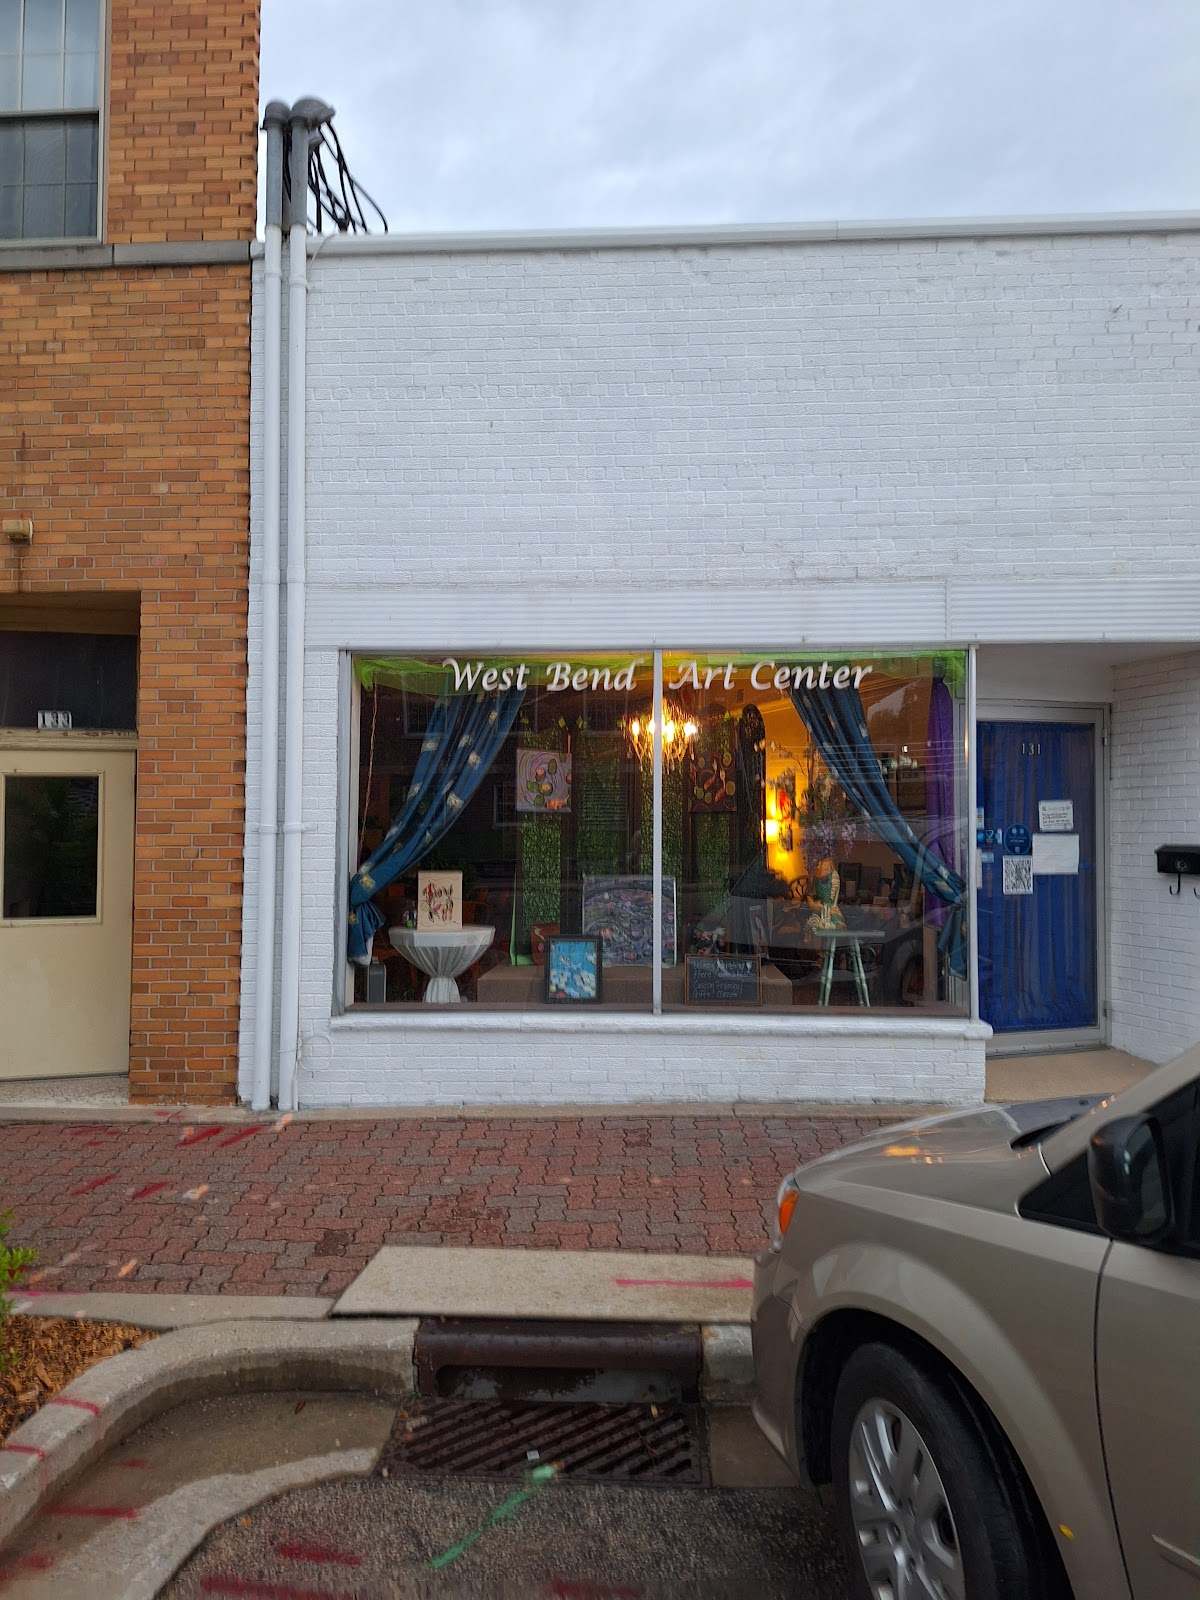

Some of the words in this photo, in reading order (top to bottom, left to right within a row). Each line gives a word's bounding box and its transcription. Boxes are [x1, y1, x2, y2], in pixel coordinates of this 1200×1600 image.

[442, 658, 530, 691] West
[546, 658, 645, 692] Bend
[668, 660, 737, 690] Art
[750, 660, 873, 690] Center
[1022, 743, 1041, 755] 131
